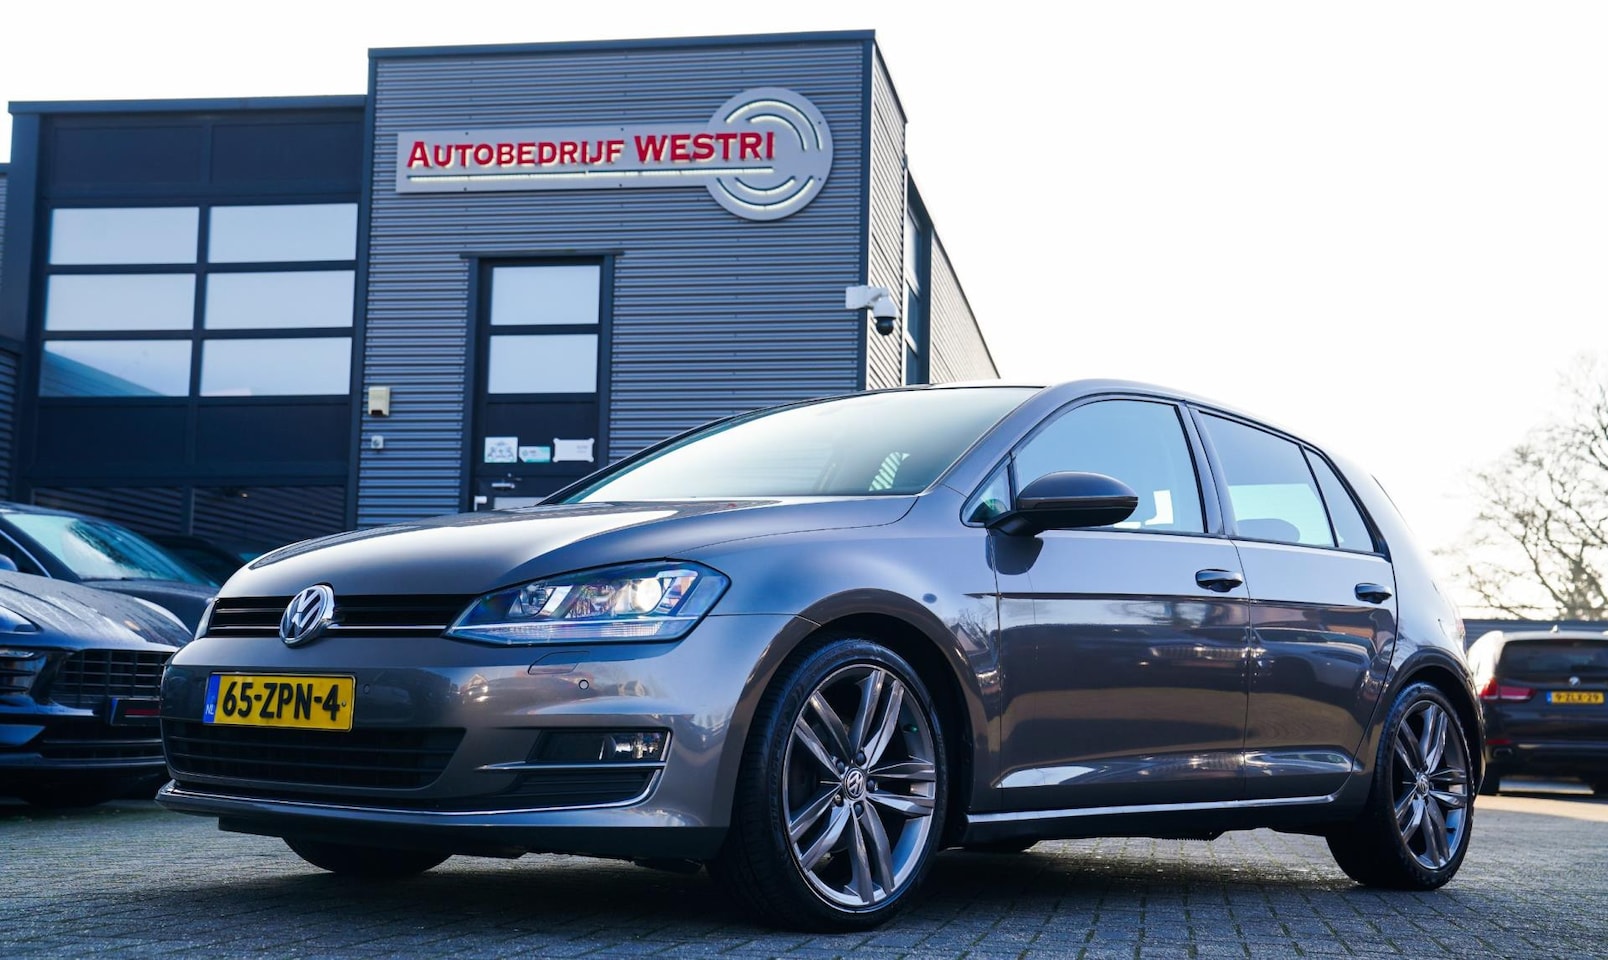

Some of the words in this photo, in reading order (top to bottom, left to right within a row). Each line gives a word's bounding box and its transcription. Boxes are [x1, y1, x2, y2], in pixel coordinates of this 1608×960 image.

[407, 140, 625, 168] AUTOBEDRIJF
[634, 131, 775, 163] WESTRI
[205, 704, 214, 715] NL
[222, 681, 340, 721] 65-ZPN-4
